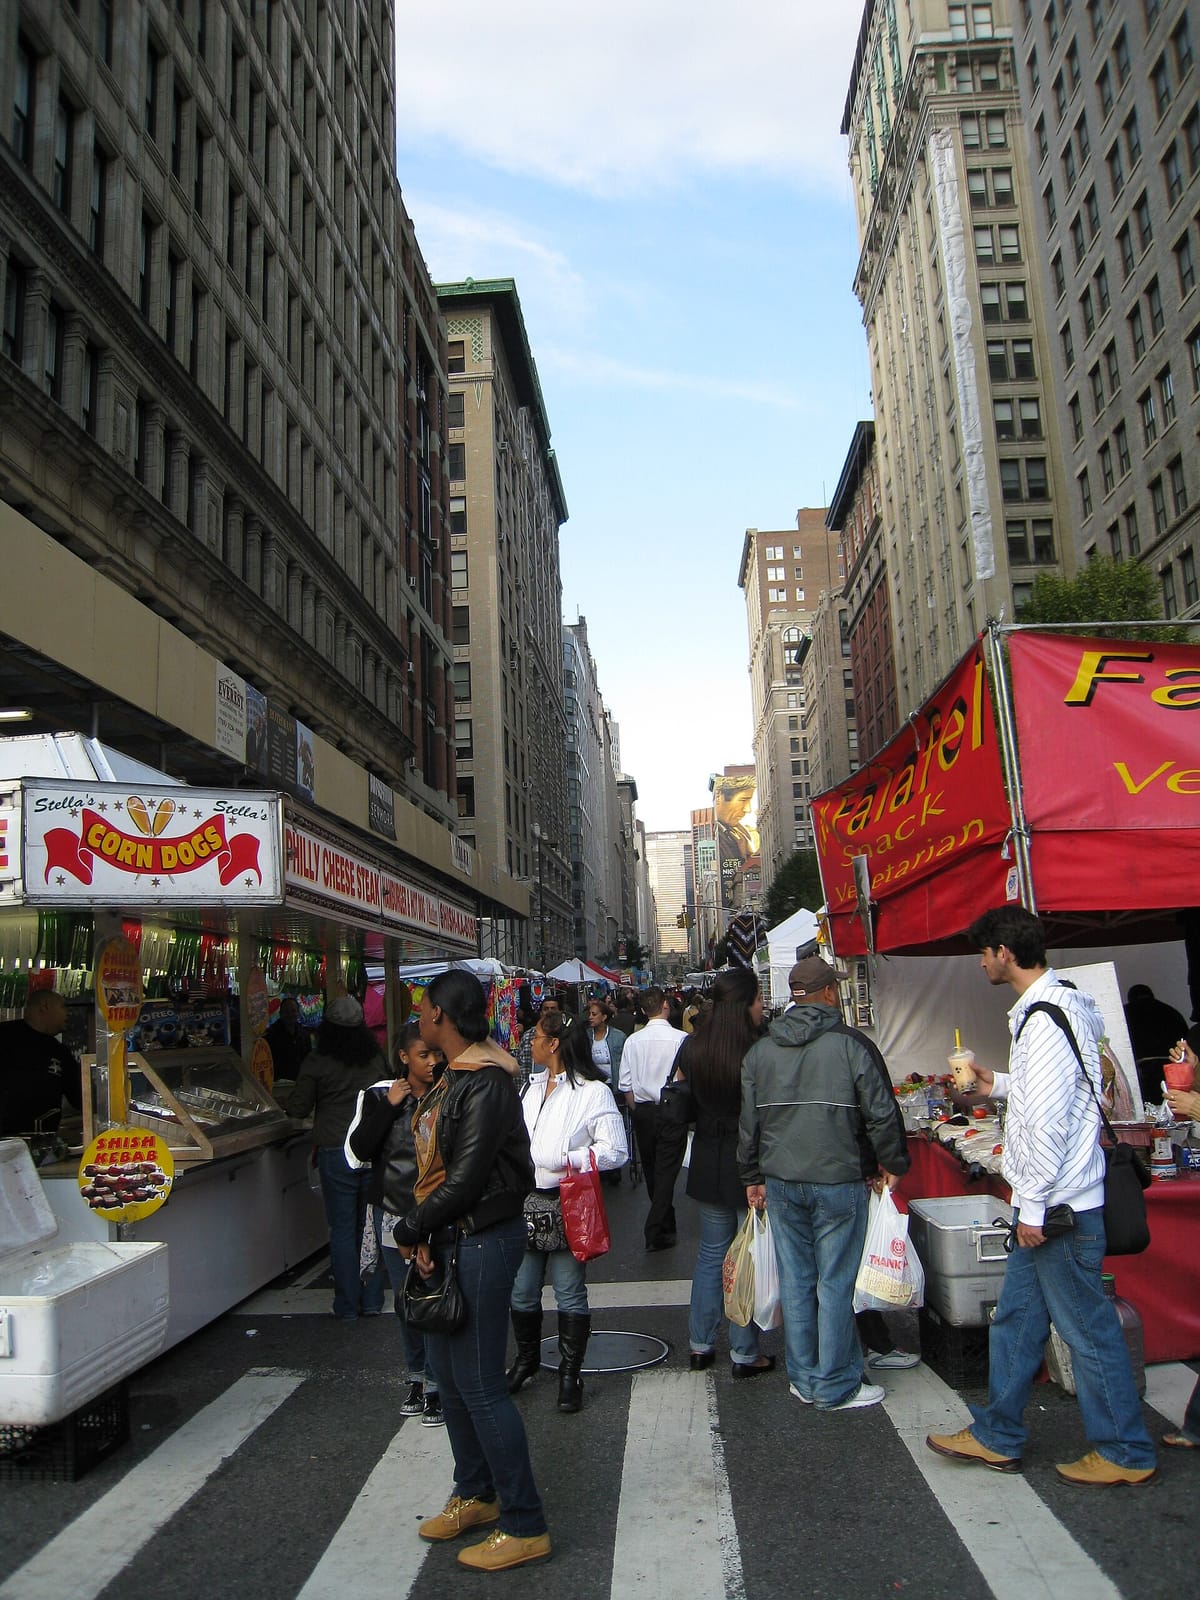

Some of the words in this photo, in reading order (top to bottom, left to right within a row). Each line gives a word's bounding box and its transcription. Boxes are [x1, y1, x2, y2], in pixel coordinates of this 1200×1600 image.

[832, 652, 984, 836] Falafel
[34, 793, 96, 813] Stella's
[213, 800, 268, 821] Stella's
[841, 791, 945, 867] Snack
[87, 823, 153, 869] CORN
[161, 826, 223, 870] DOGS
[285, 828, 320, 882] PHILLY
[322, 847, 355, 896] CHEESE
[356, 864, 380, 905] STEAK
[835, 818, 984, 902] Veetarian
[108, 1007, 138, 1021] STEAK
[140, 1009, 174, 1023] OREO
[96, 1136, 155, 1151] SHISH
[94, 1151, 157, 1165] KEBAB
[870, 1254, 902, 1270] THANK
